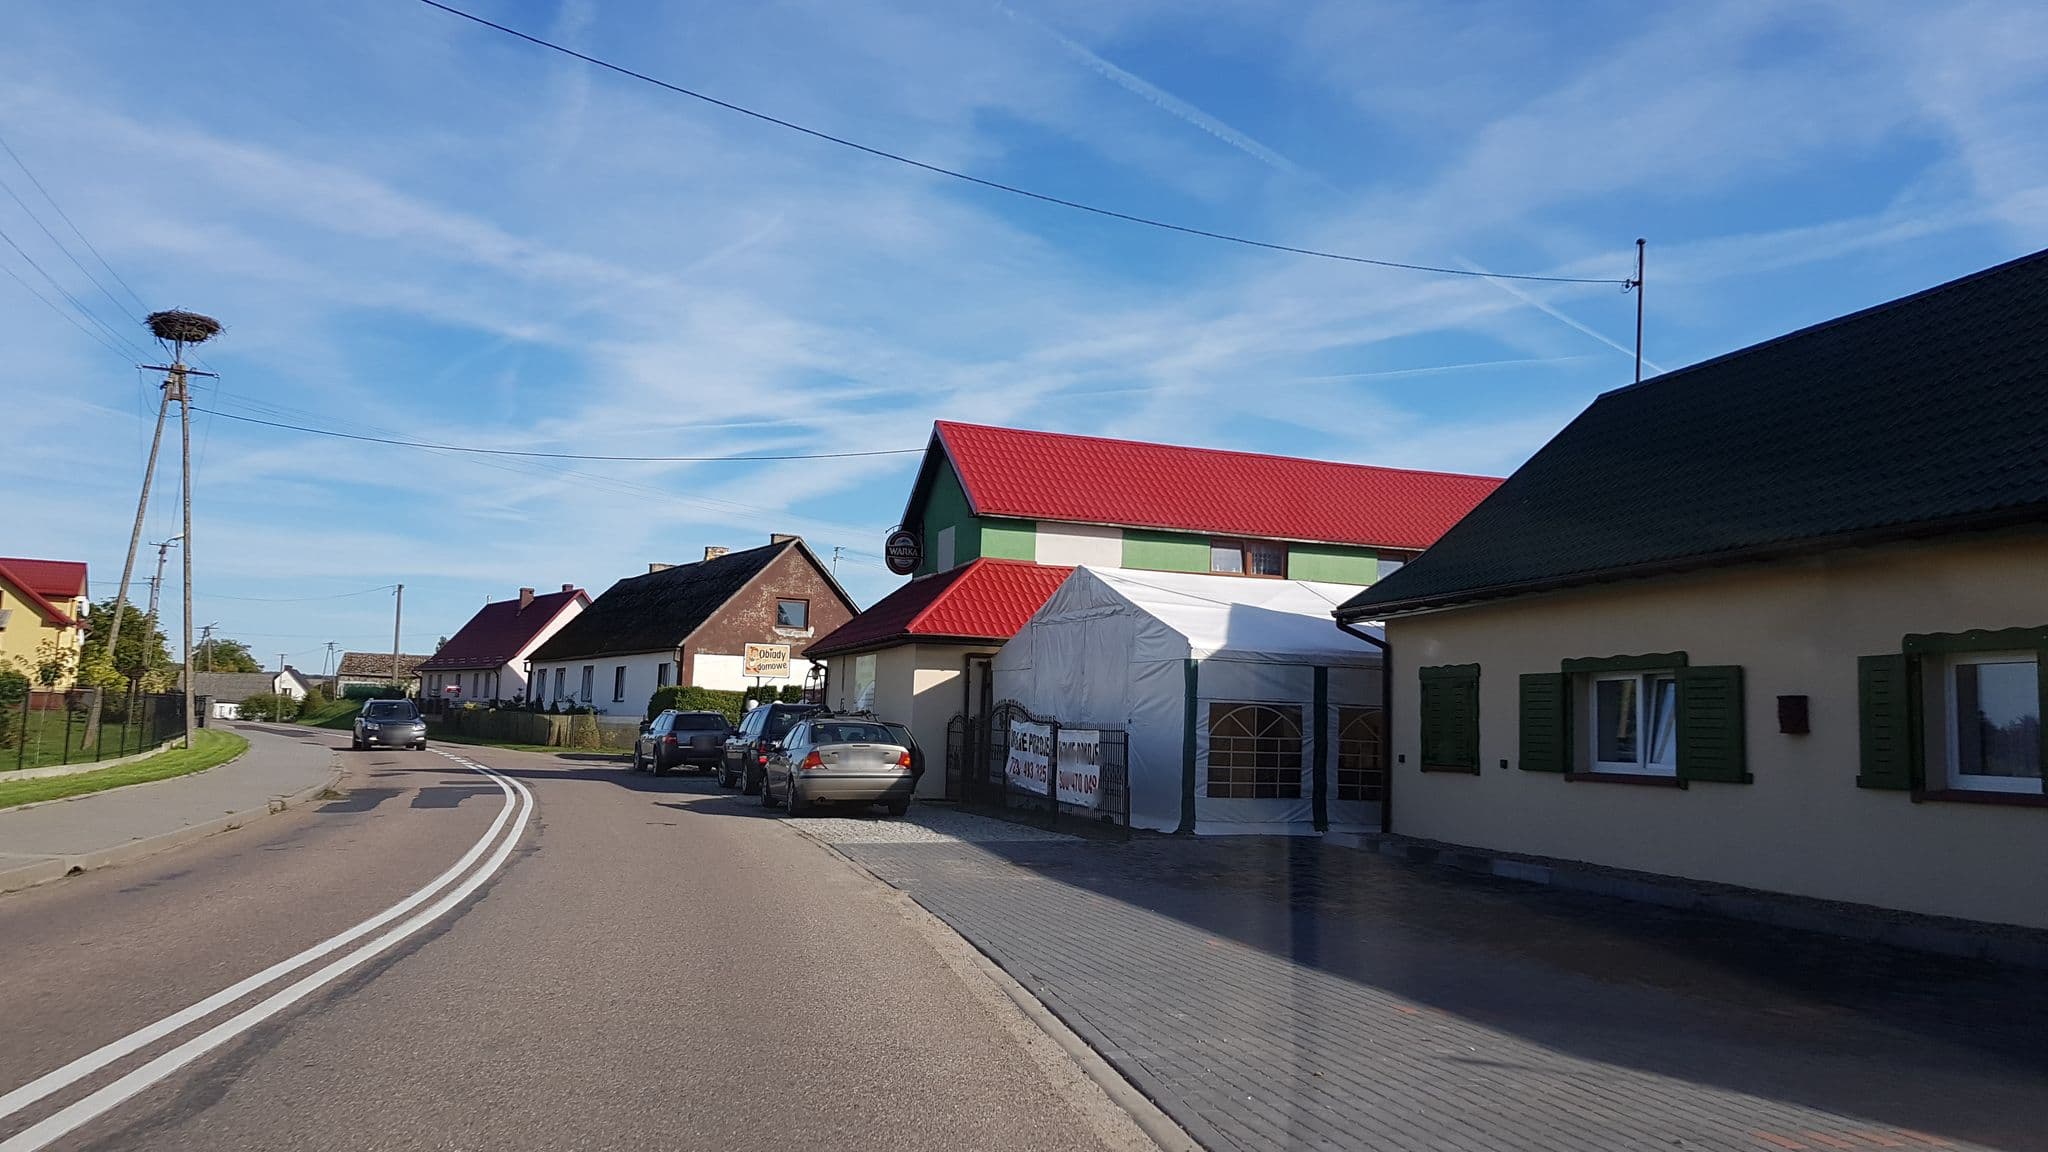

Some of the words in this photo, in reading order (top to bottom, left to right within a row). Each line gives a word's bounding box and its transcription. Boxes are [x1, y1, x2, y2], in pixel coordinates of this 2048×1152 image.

[888, 547, 918, 557] WARKA
[759, 648, 786, 661] Obiady
[757, 663, 787, 671] domowe
